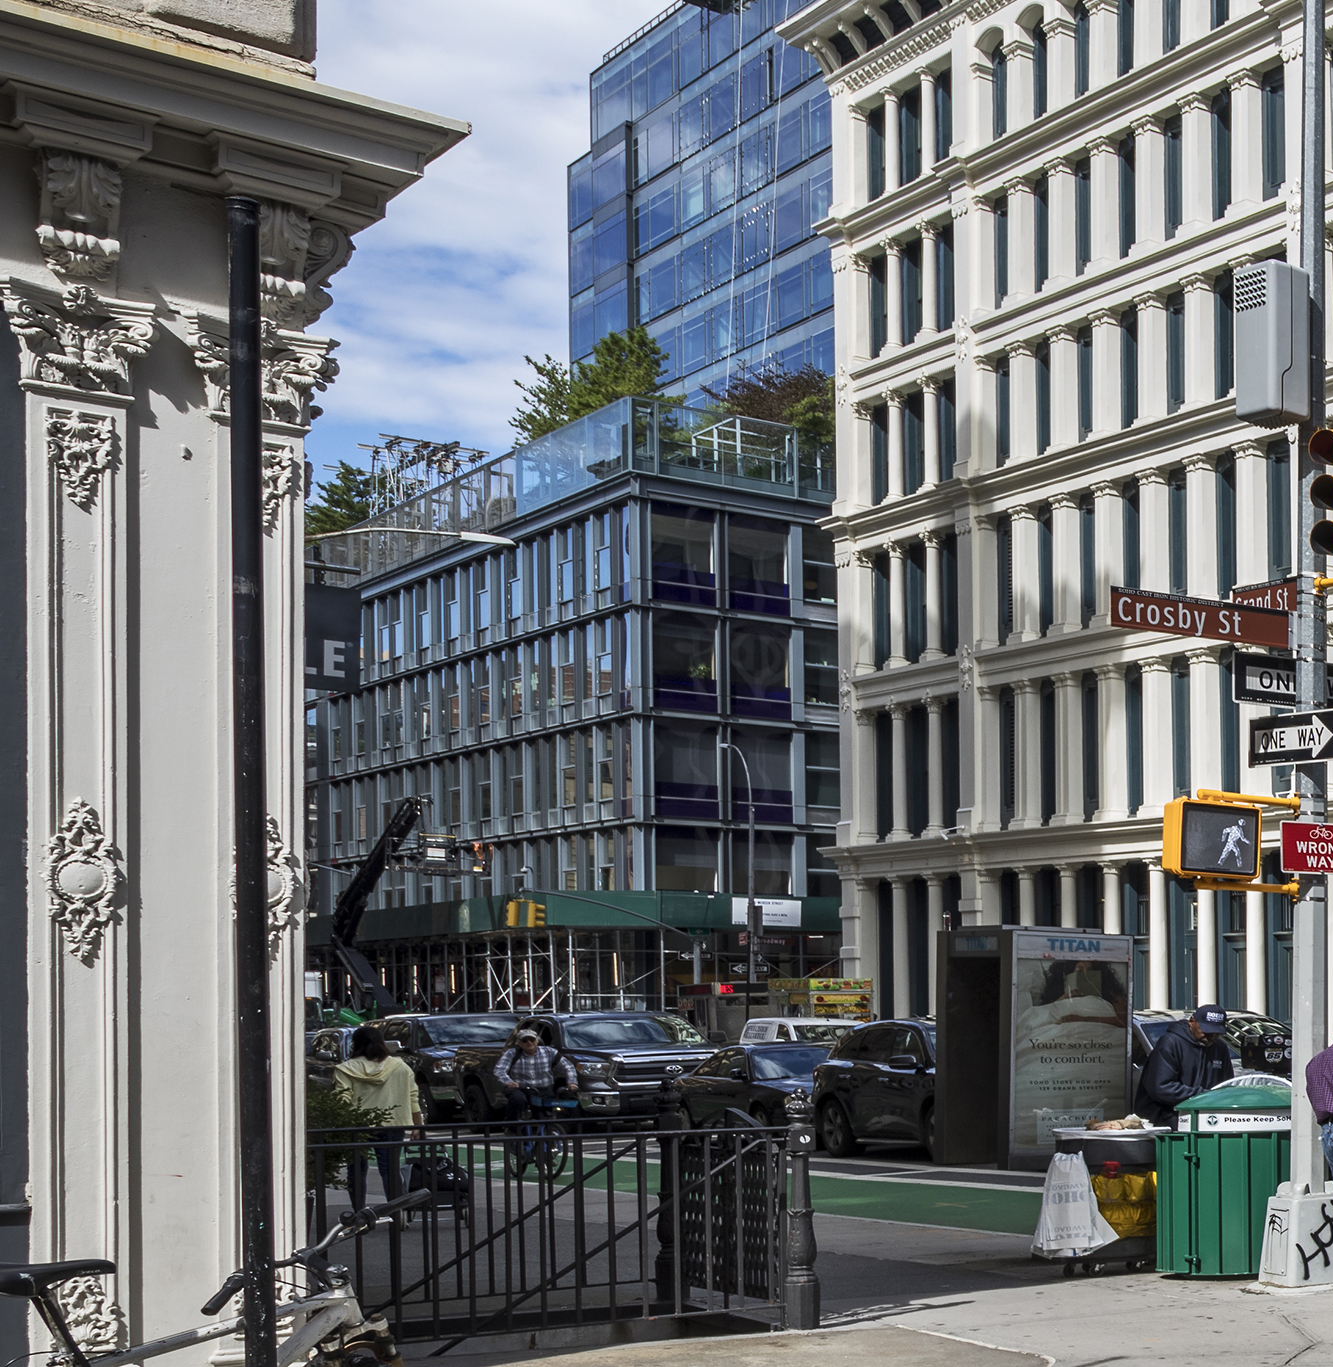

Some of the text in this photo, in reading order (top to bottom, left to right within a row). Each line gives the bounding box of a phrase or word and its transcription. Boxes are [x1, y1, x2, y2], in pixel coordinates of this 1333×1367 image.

[1118, 588, 1135, 596] SOHO
[1136, 590, 1152, 598] CAST
[1169, 595, 1197, 604] HISTORIC
[1197, 598, 1224, 608] DISTRICT
[1276, 587, 1288, 610] St
[1118, 596, 1242, 637] Crosby St
[1259, 670, 1296, 692] ON
[1261, 727, 1324, 751] ONE WAY
[1047, 938, 1100, 953] TITAN
[1029, 1038, 1113, 1050] You're so close
[1040, 1053, 1105, 1064] to comfort.
[1253, 1115, 1275, 1123] Keep
